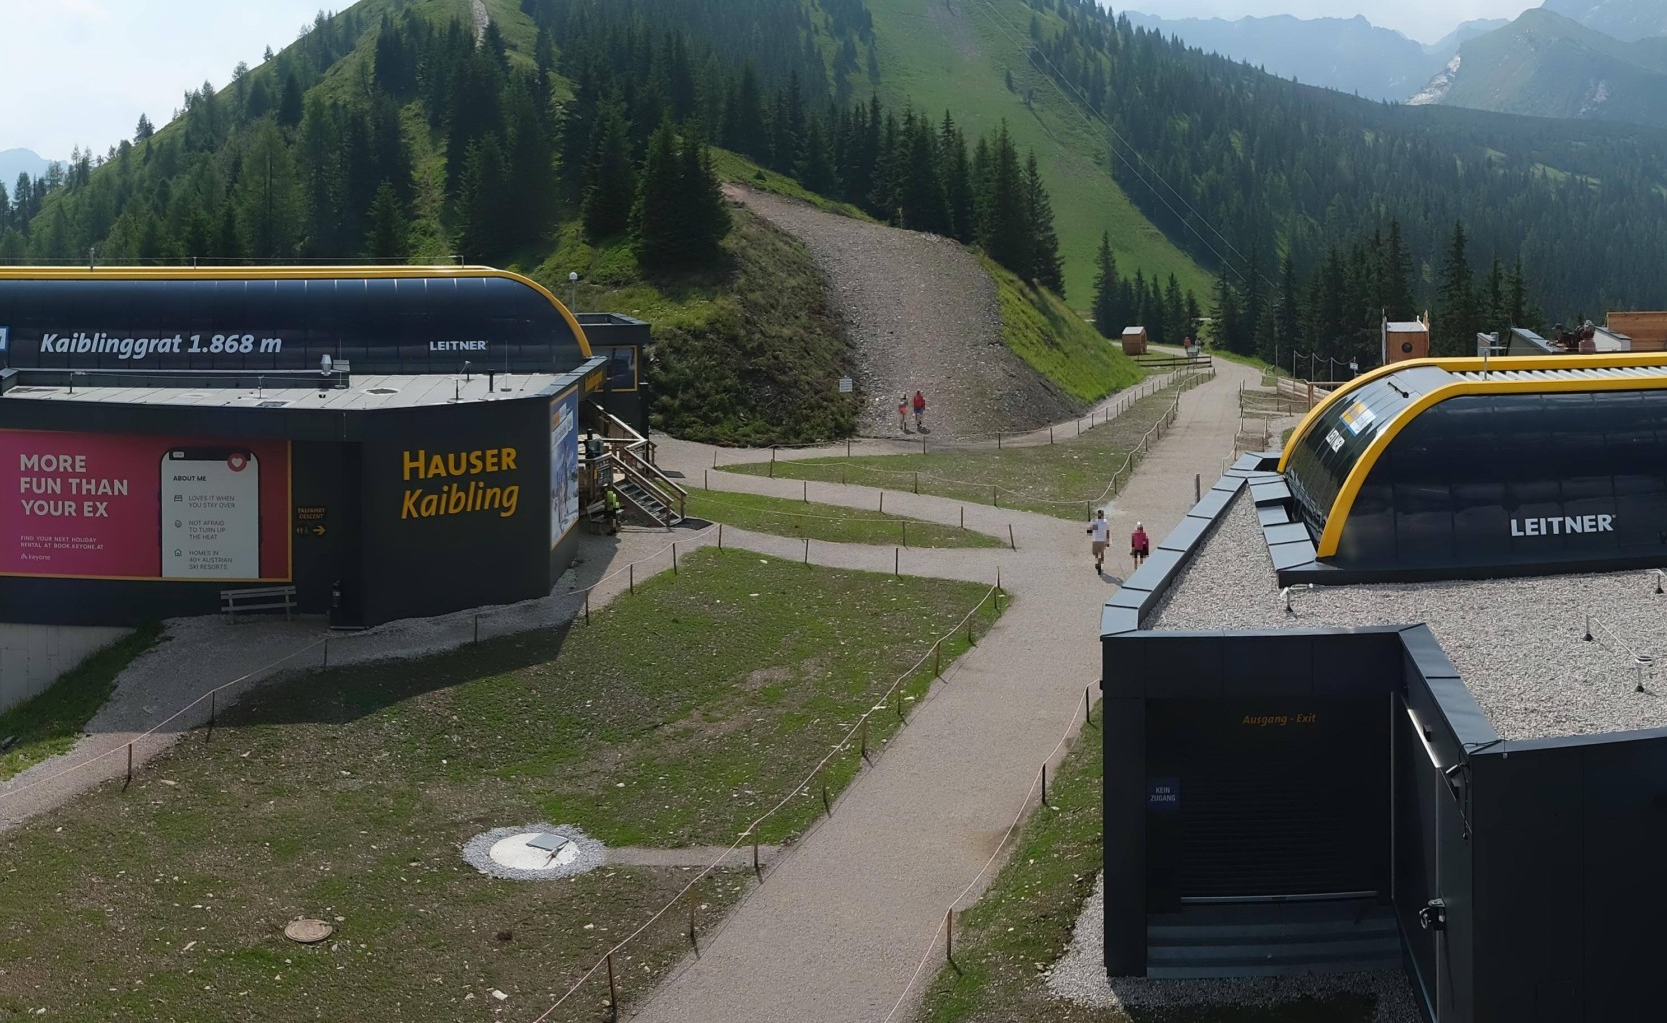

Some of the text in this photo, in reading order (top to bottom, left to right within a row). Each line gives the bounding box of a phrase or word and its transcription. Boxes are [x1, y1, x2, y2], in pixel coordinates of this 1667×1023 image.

[40, 332, 282, 359] Kaiblinggrat 1.868 m
[429, 340, 487, 352] LEITNER
[20, 454, 87, 473] MORE
[402, 447, 518, 481] HAUSER
[20, 478, 129, 496] FUN THAN
[21, 499, 109, 518] YOUR EX
[400, 481, 520, 520] Kaibling
[1510, 514, 1614, 537] LEITNER
[1242, 715, 1288, 727] Ausgang
[1296, 713, 1317, 723] Exit
[1150, 794, 1176, 802] ZUGANG
[1155, 786, 1171, 794] KEIN
